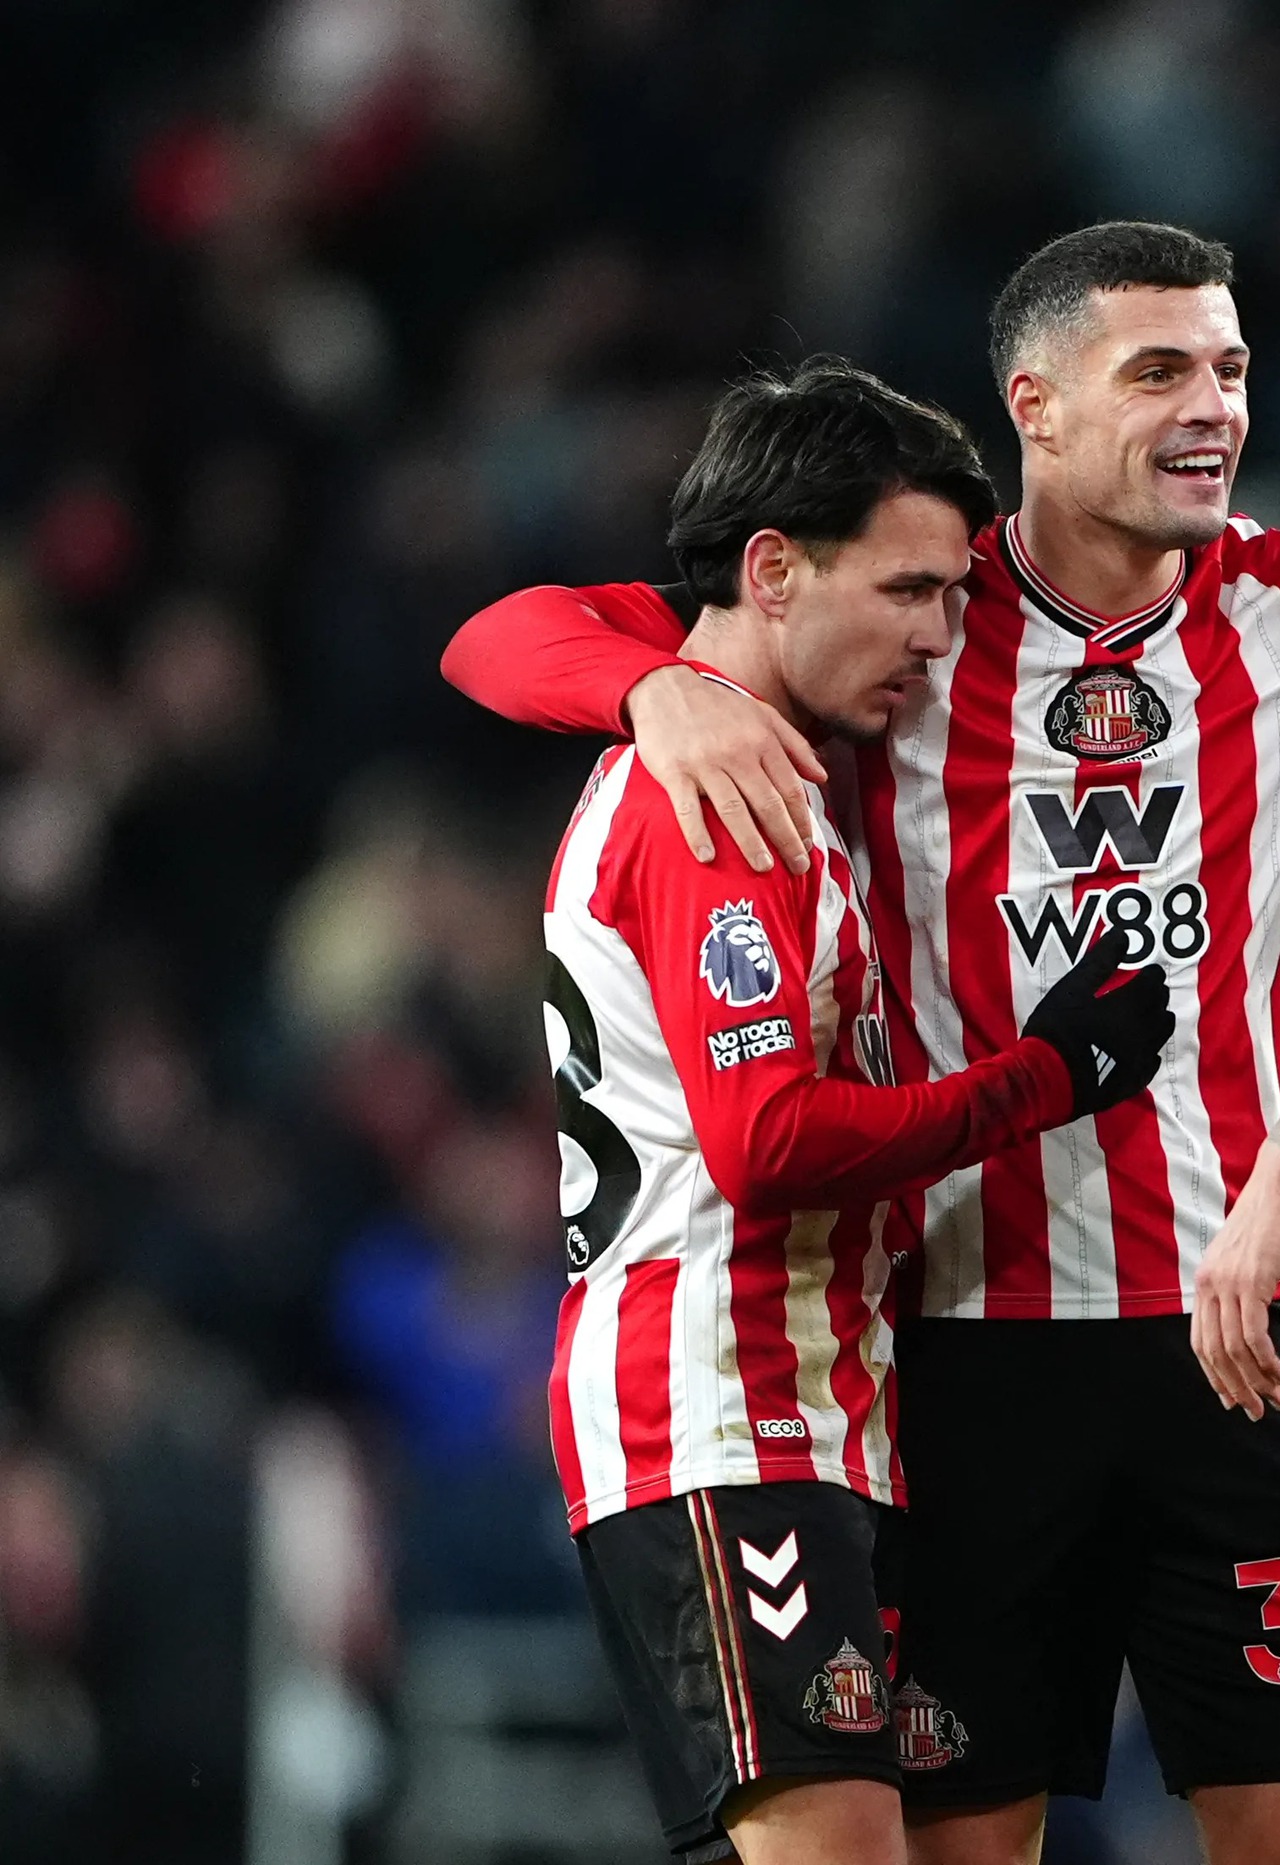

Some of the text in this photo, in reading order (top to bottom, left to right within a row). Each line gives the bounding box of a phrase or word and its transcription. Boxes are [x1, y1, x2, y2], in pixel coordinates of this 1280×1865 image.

[1025, 785, 1186, 868] W
[999, 882, 1206, 968] W88
[707, 1019, 792, 1052] No room
[713, 1046, 741, 1071] for
[759, 1421, 803, 1435] ECO8
